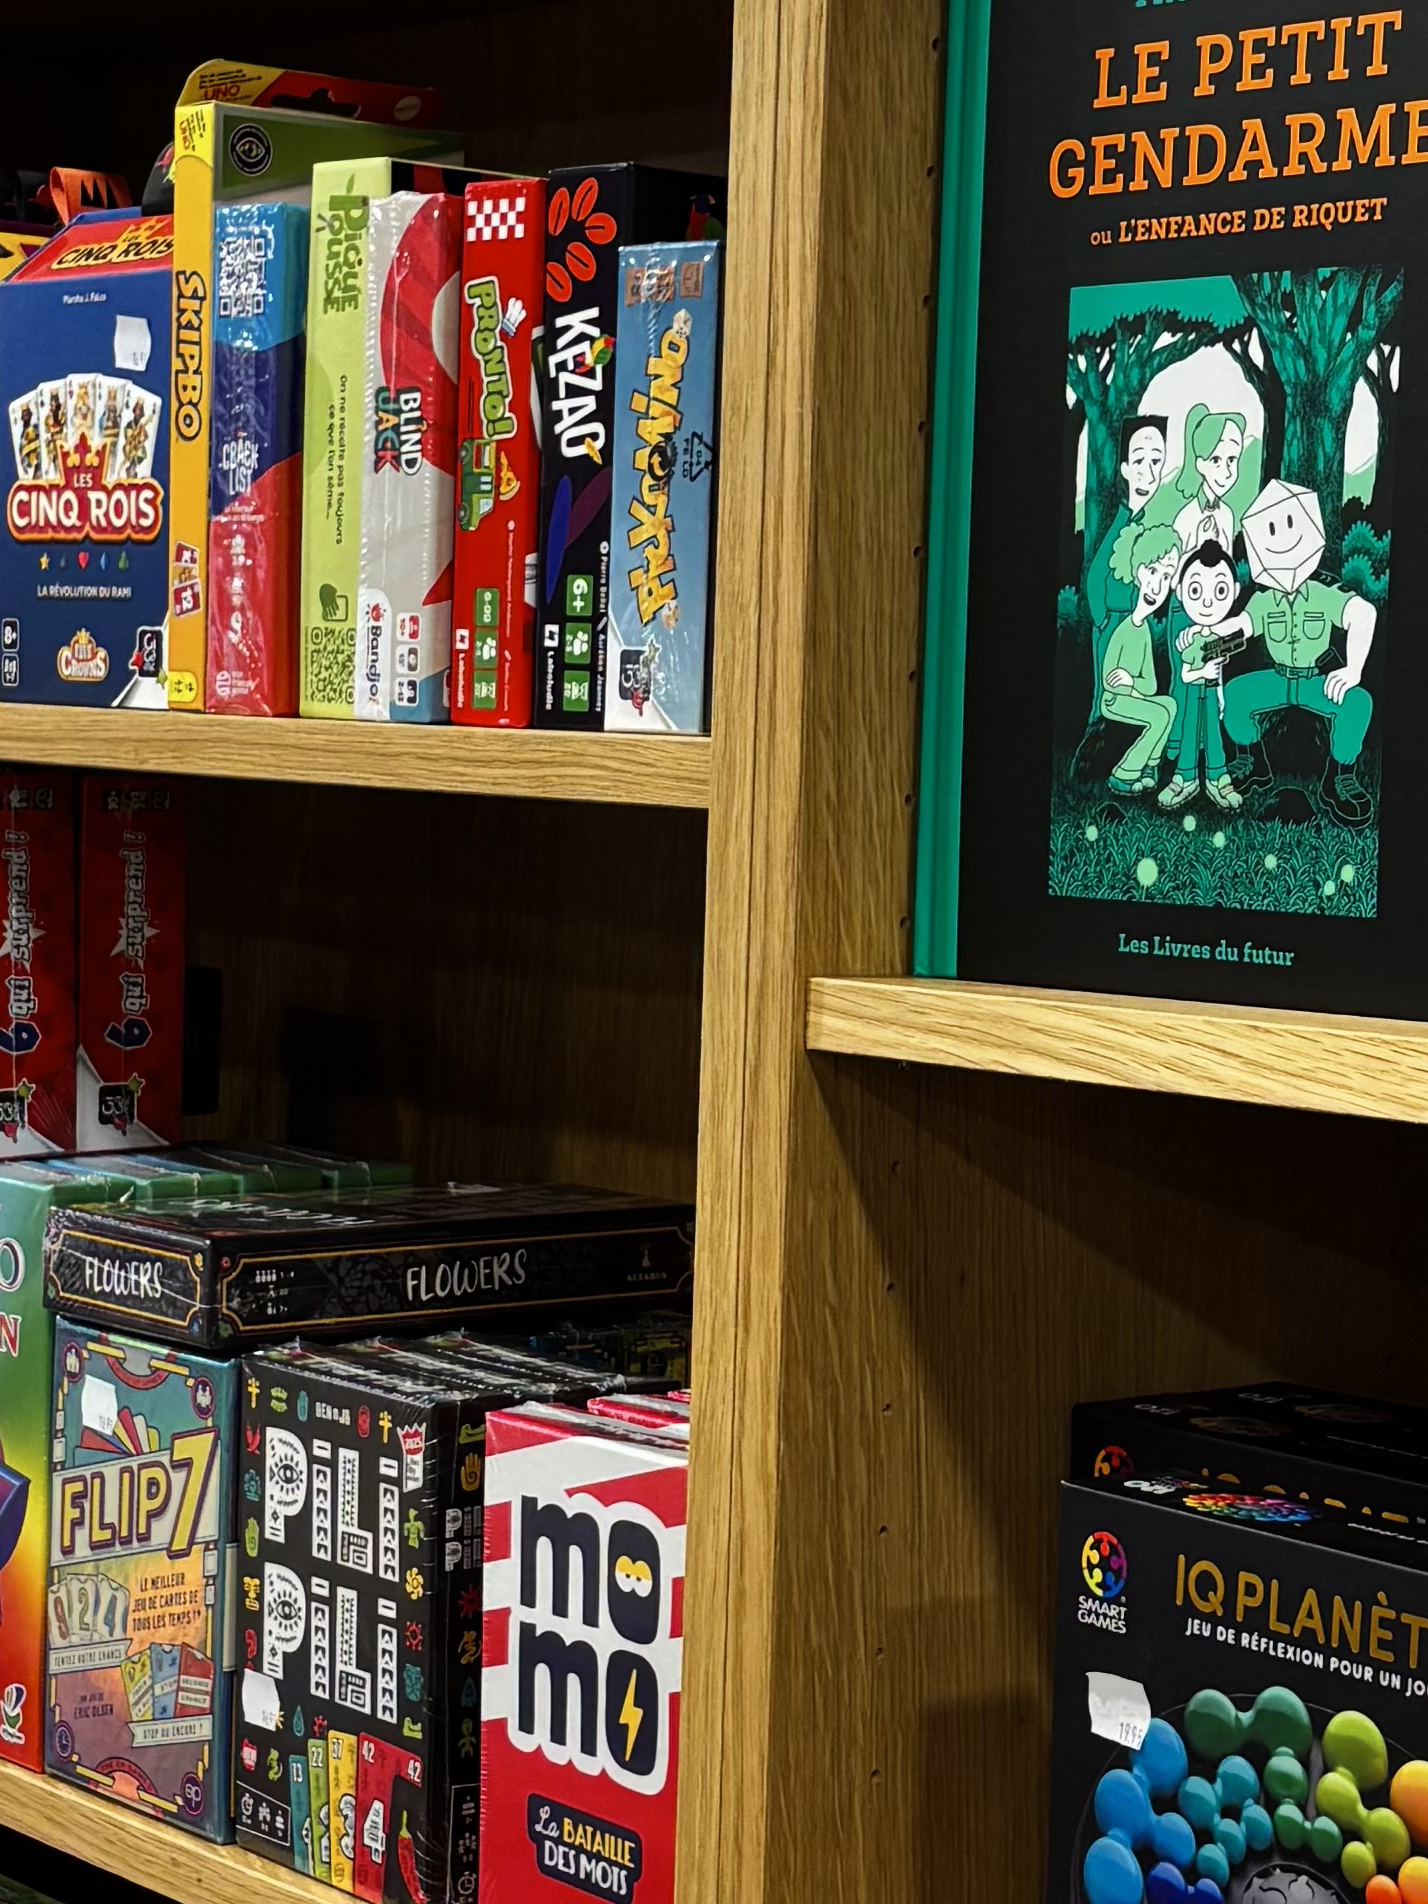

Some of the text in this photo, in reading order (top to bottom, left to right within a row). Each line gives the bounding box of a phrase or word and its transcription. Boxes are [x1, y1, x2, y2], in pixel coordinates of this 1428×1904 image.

[1093, 10, 1404, 109] LE PETIT
[1118, 207, 1247, 244] L'ENFANCE
[1253, 204, 1285, 233] DE
[1291, 196, 1389, 231] RIQUET
[174, 269, 208, 442] SKIPBO
[547, 305, 606, 460] KEZAO
[374, 385, 402, 475] JACK
[399, 387, 423, 476] BLIND
[13, 487, 159, 529] CINQ ROIS
[1118, 932, 1296, 967] Les Livres du futur
[82, 1255, 164, 1299] FLOWERS
[405, 1249, 528, 1302] FLOWERS
[60, 1429, 219, 1559] FLIP 7
[1078, 1596, 1128, 1620] SMART
[1175, 1554, 1226, 1617] IQ
[1077, 1609, 1127, 1634] GAMES
[1186, 1617, 1211, 1637] JEU
[1216, 1625, 1236, 1644] DE
[1241, 1631, 1324, 1670] RÉFLEXION
[1329, 1657, 1373, 1682] POUR
[1379, 1671, 1401, 1690] UN
[543, 1839, 630, 1897] DES MOTS
[562, 1817, 637, 1869] BATAILLE
